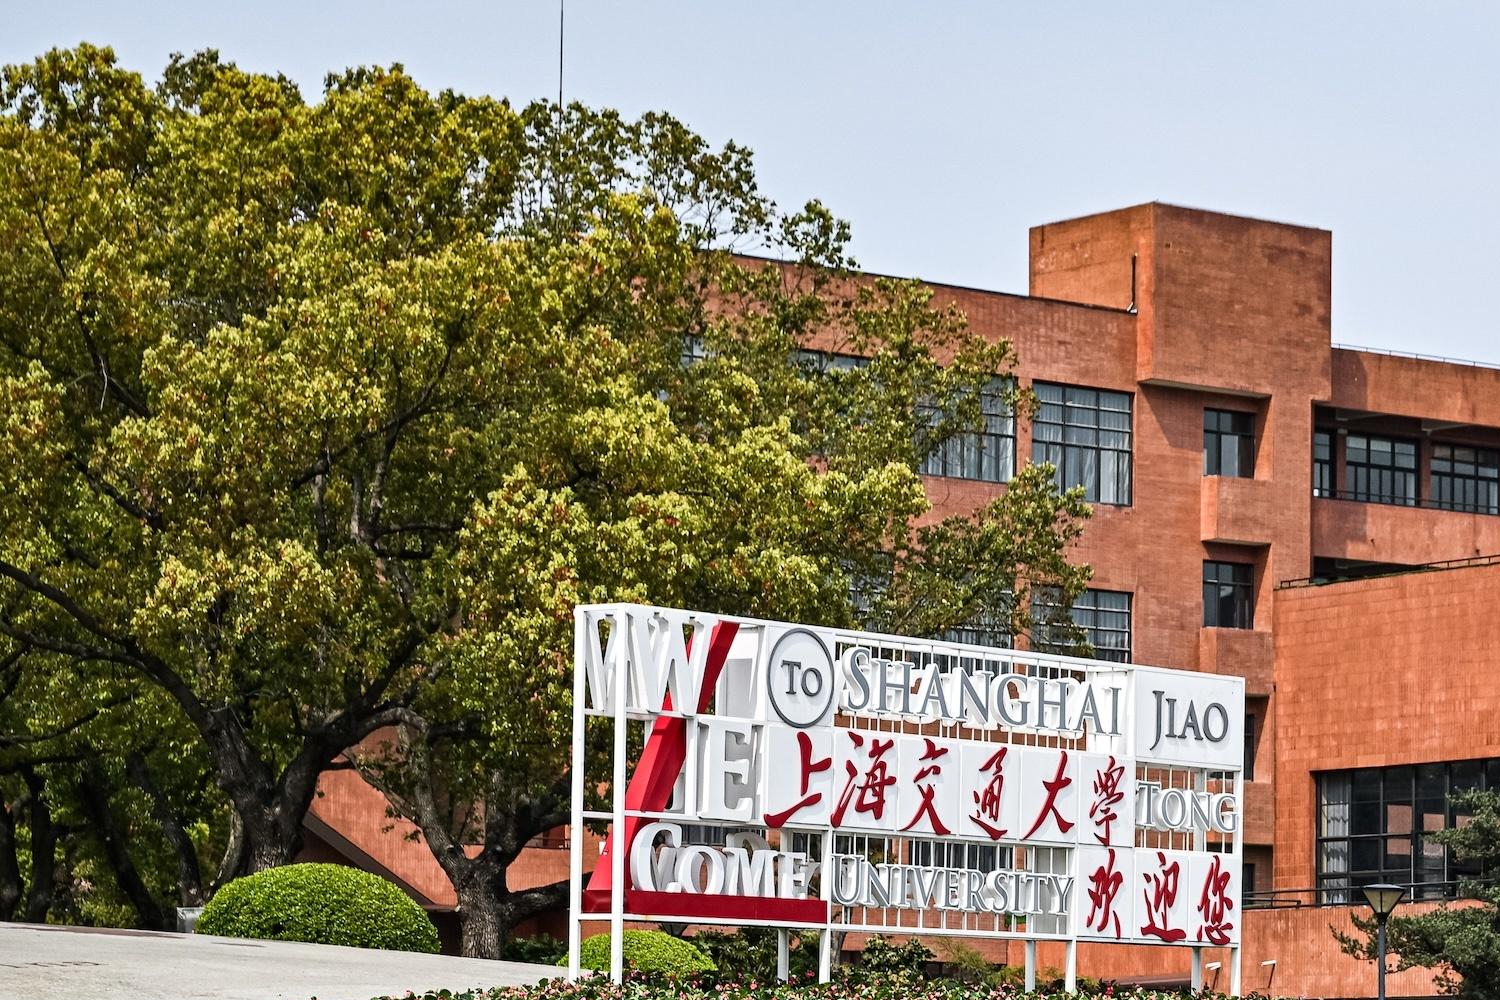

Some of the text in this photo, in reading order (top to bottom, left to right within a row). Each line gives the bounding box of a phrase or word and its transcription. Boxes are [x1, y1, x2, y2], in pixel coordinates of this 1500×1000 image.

[841, 647, 1123, 737] SHANGHAI
[1149, 690, 1229, 751] JIAO
[1136, 780, 1238, 834] TONG
[630, 822, 807, 900] COME
[831, 853, 1074, 915] UNIVERSITY
[1086, 848, 1234, 946] 欢迎您
